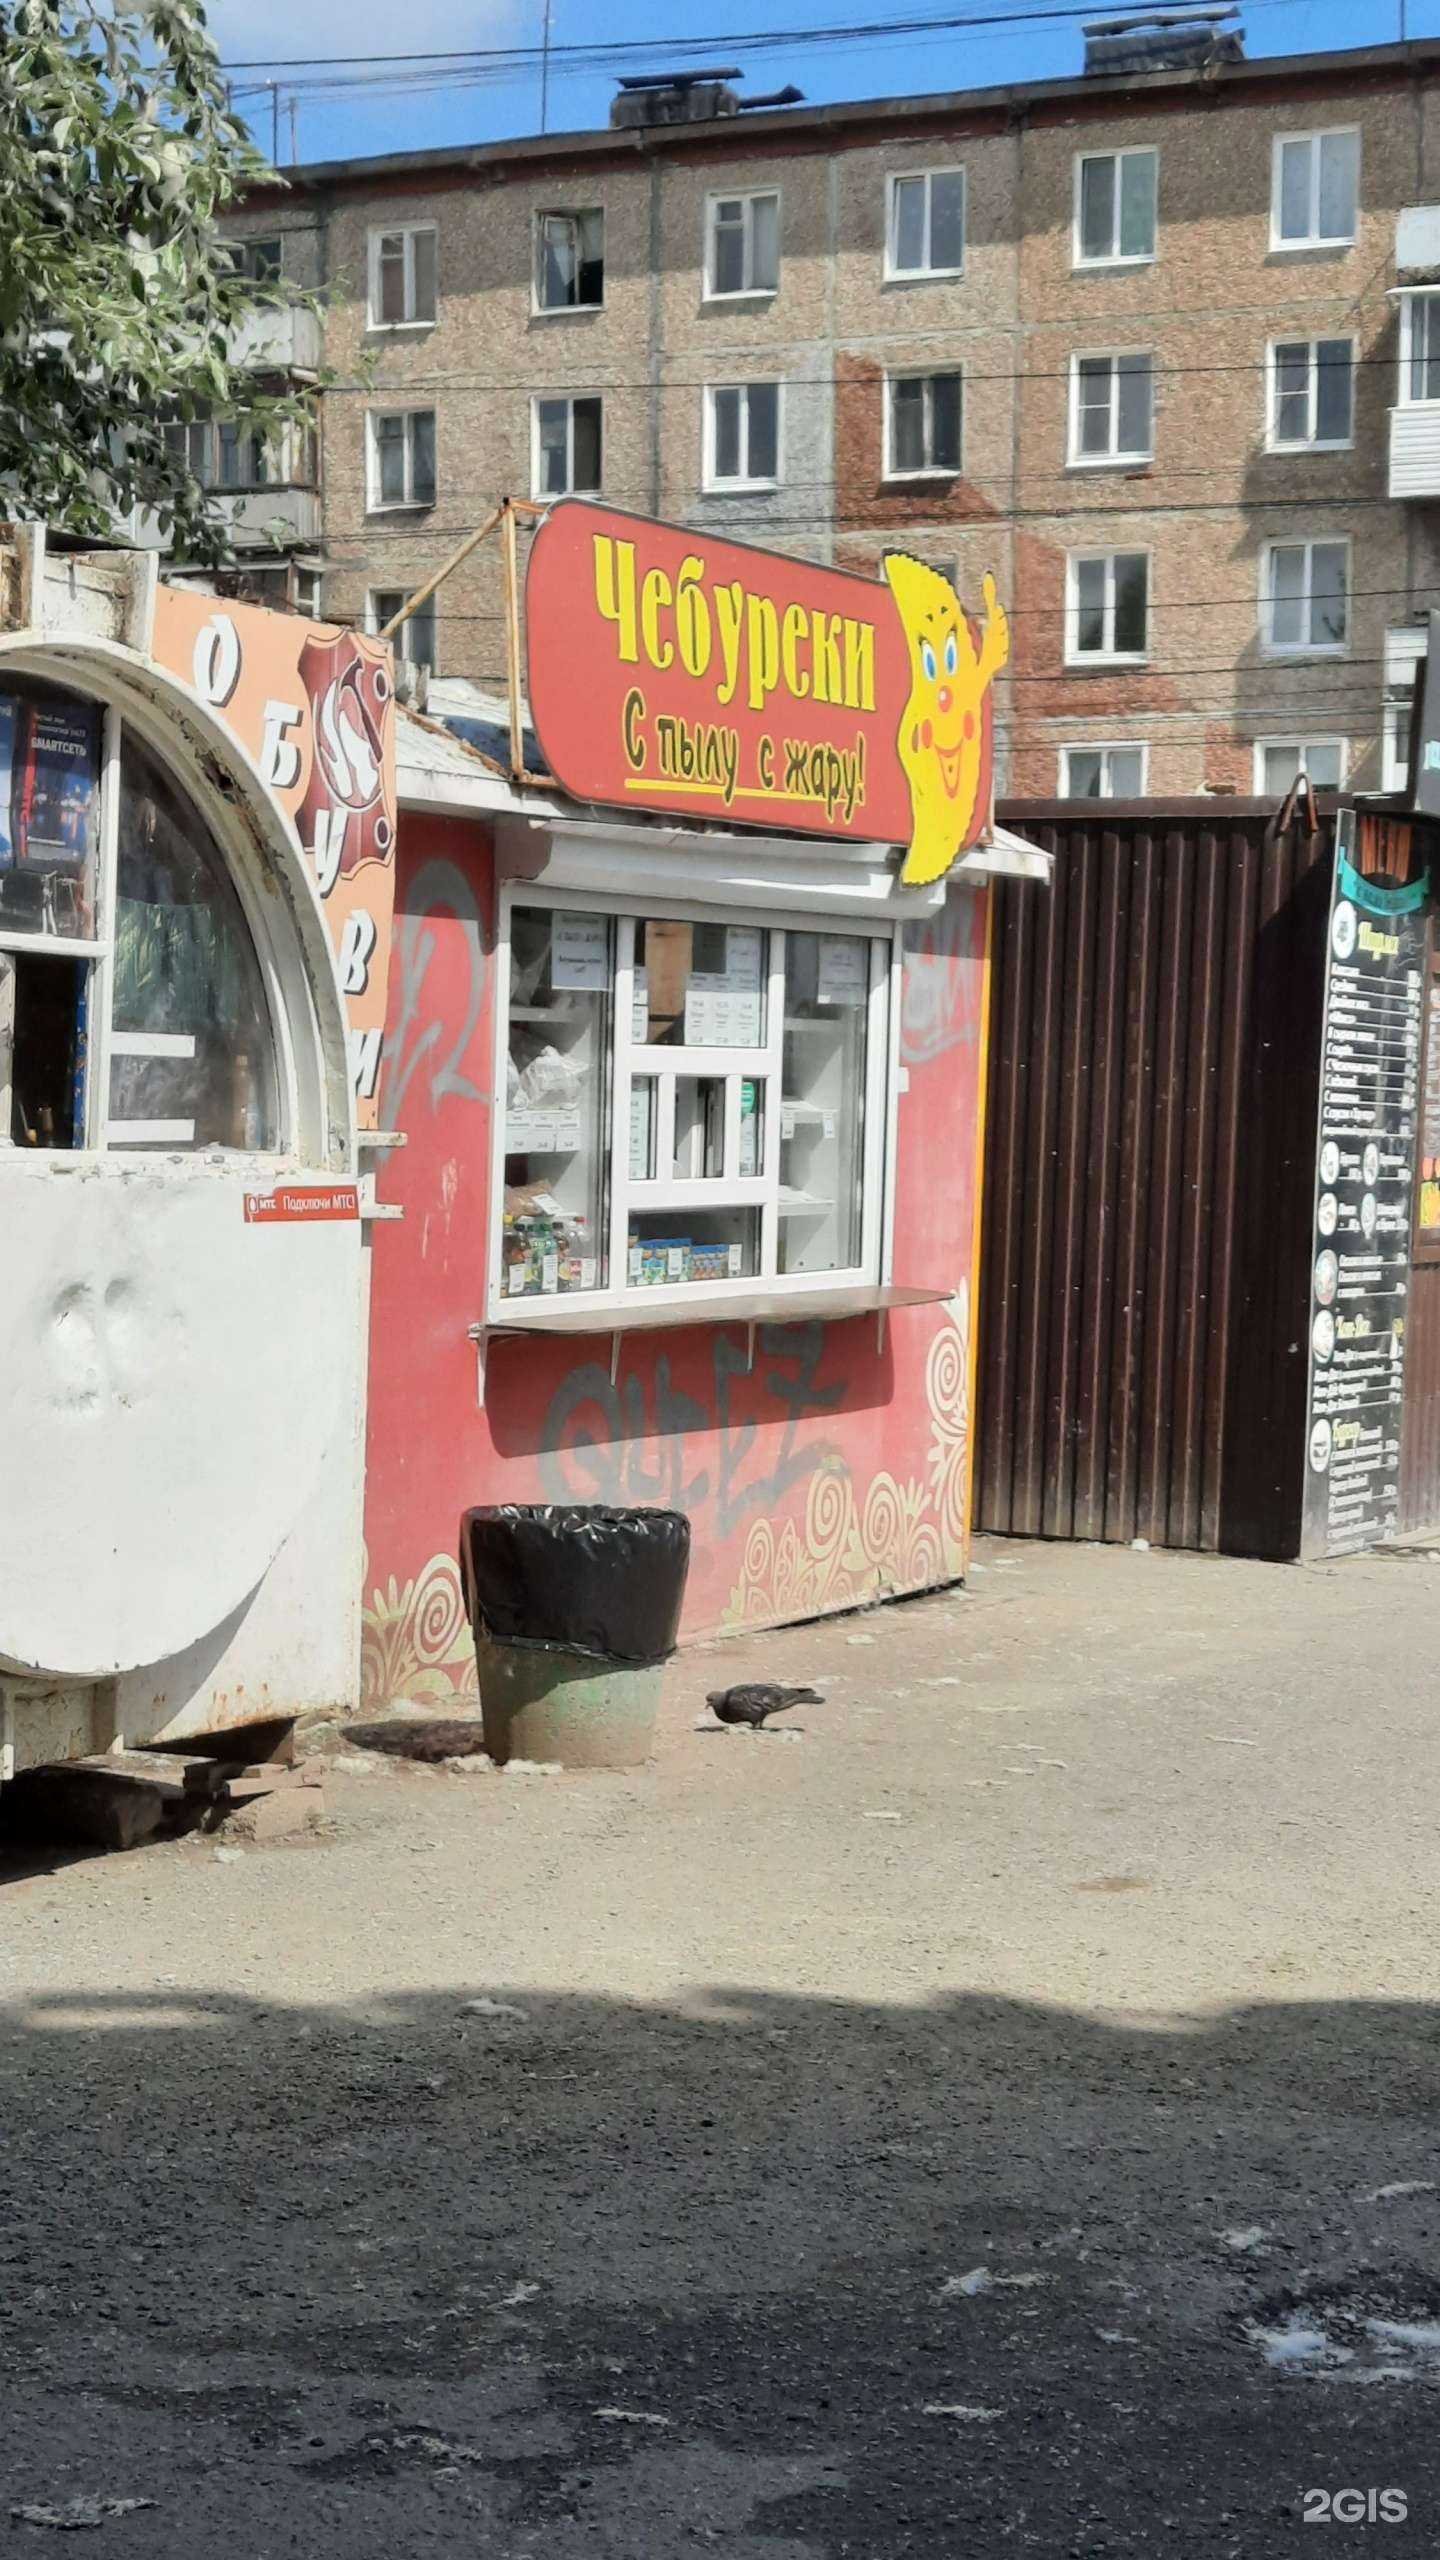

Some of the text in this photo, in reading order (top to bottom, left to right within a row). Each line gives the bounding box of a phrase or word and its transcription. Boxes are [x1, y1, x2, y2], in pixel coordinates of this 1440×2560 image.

[595, 535, 877, 711] Чебуреки
[622, 687, 866, 824] С пылу с жару!
[283, 1195, 331, 1213] Подключи
